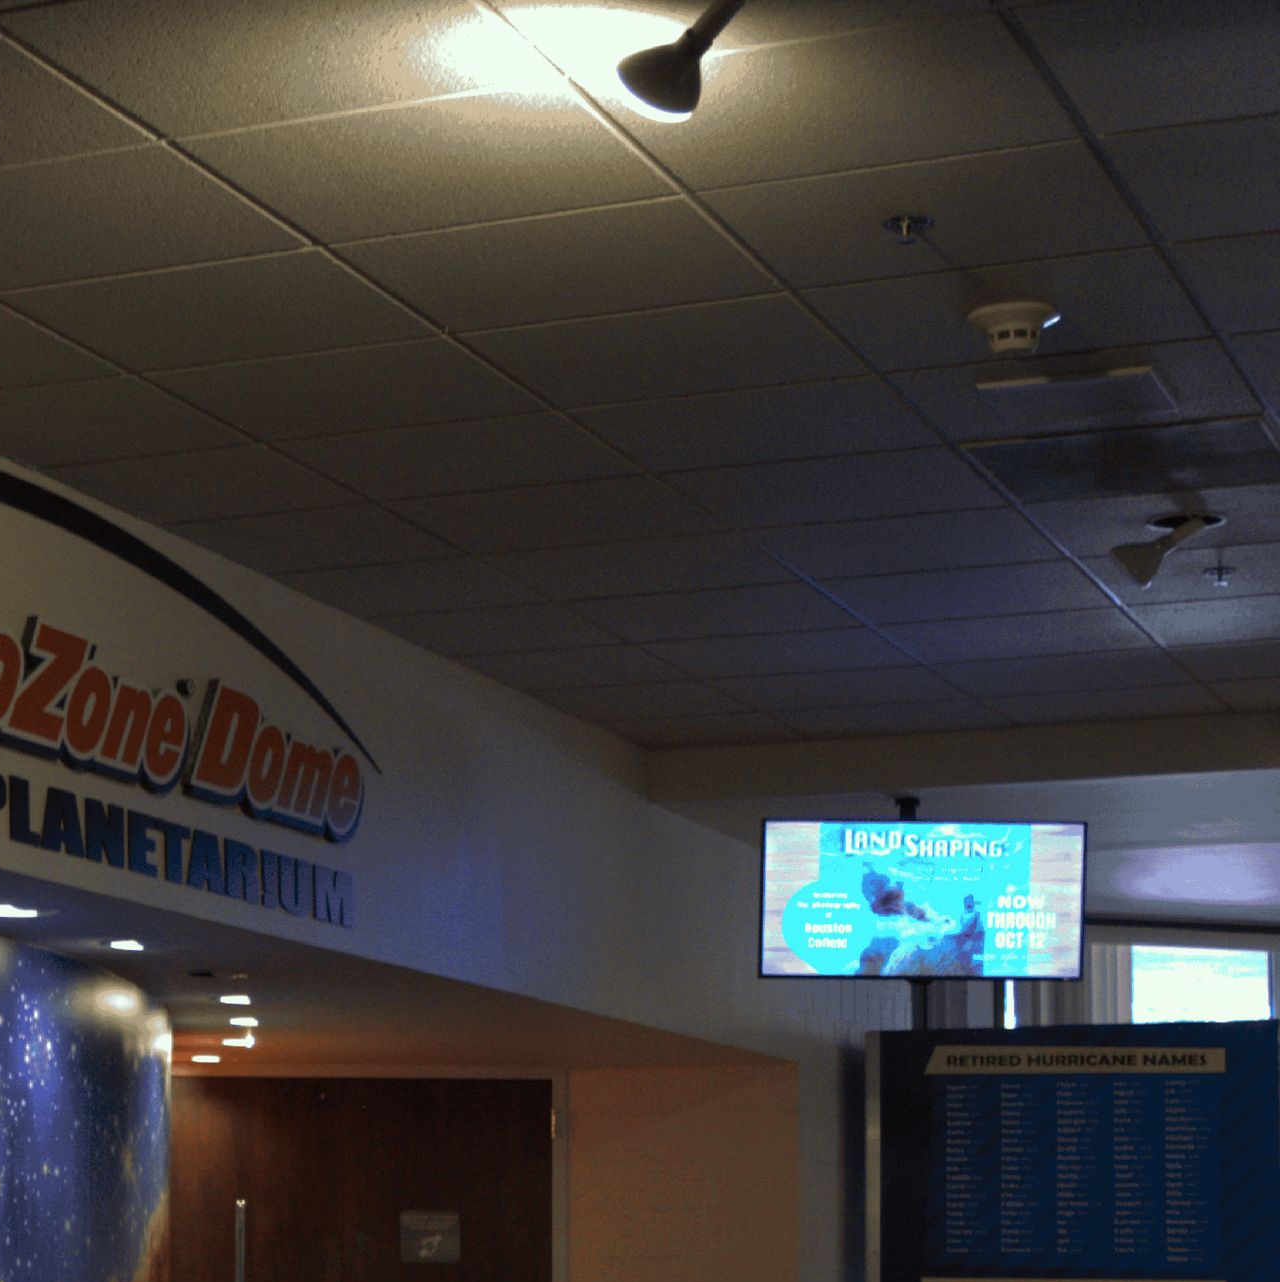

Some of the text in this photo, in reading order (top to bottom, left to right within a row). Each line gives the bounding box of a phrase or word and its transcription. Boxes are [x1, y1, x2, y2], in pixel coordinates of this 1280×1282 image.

[192, 686, 361, 832] Dome
[997, 895, 1045, 909] NOW
[987, 912, 1056, 928] THROUGH
[995, 931, 1046, 948] OCT 12
[947, 1054, 1207, 1067] RETIRED HURRICANE NAMES
